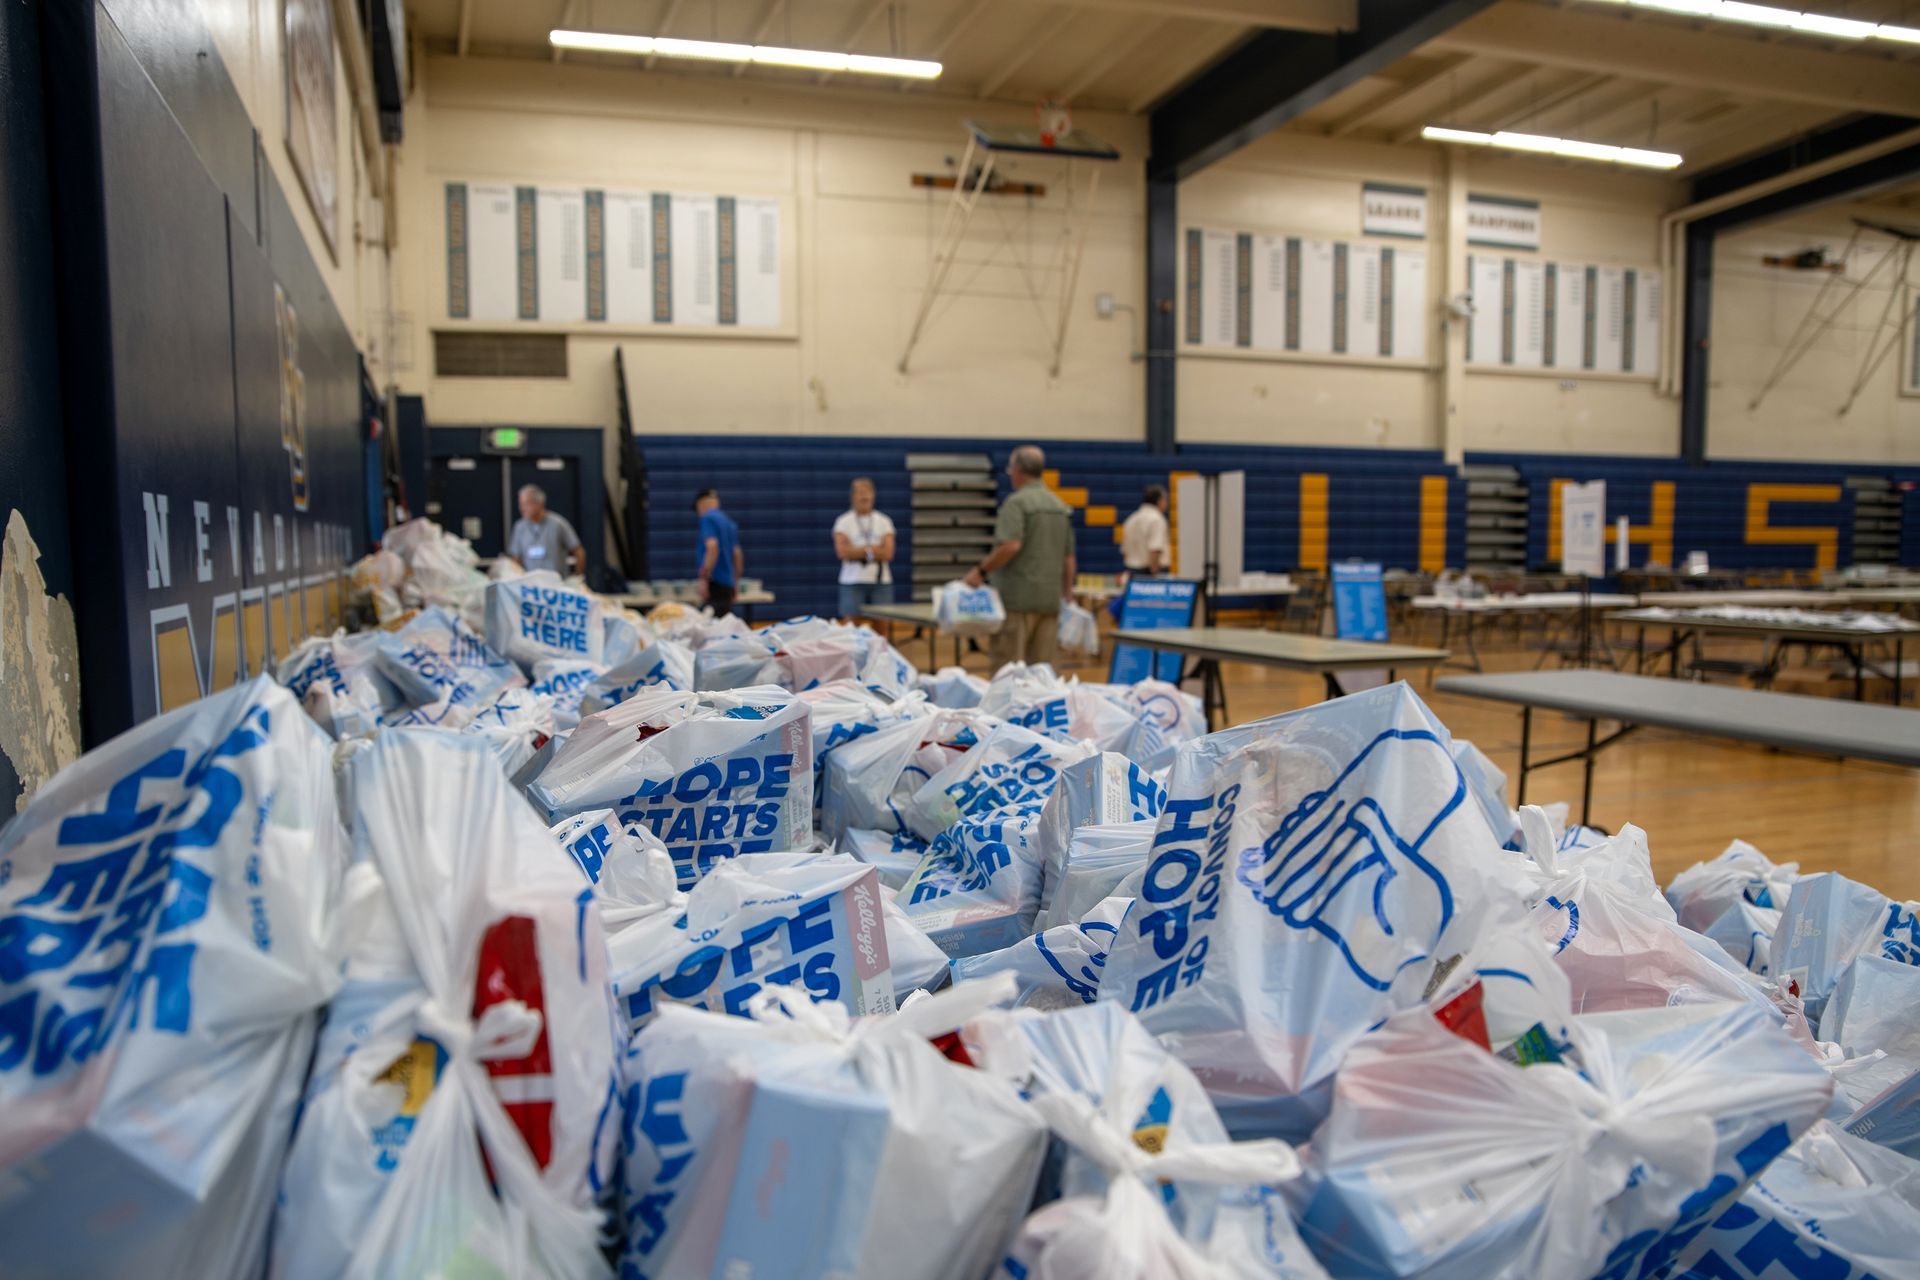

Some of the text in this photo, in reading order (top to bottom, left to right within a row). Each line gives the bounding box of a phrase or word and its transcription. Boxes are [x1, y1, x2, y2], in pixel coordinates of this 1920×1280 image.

[520, 584, 589, 612] HOPE
[520, 619, 588, 653] HERE
[619, 753, 795, 806] HOPE
[1193, 783, 1241, 922] CONVOY
[854, 884, 878, 965] Kellogg's
[1130, 793, 1216, 1013] HOPE
[1181, 935, 1209, 987] OF
